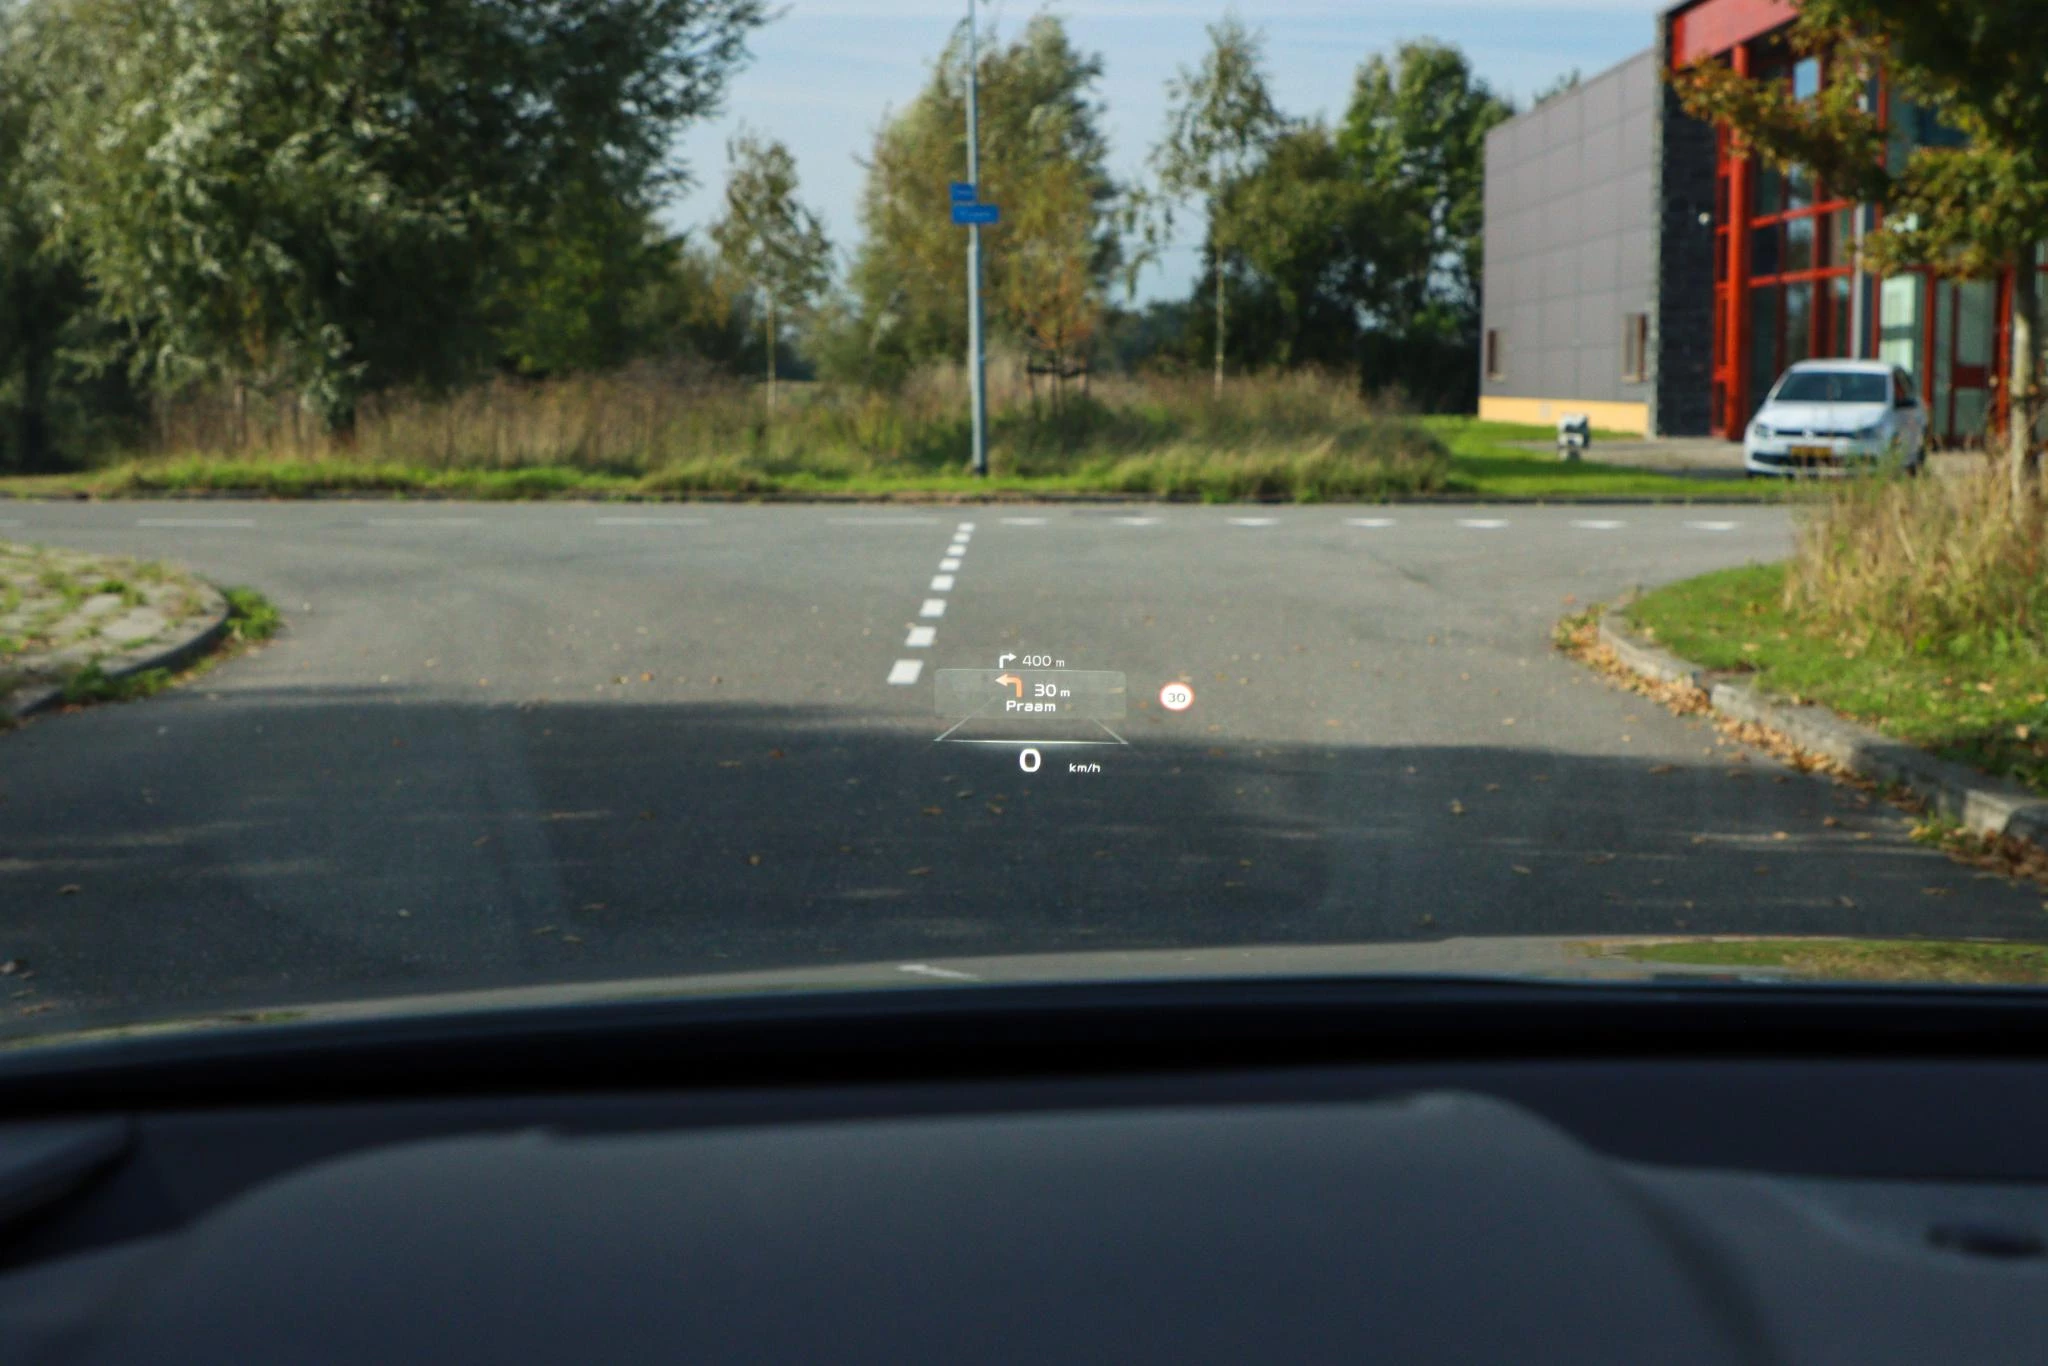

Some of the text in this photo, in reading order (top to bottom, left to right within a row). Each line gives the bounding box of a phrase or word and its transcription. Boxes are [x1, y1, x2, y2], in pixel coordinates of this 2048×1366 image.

[1022, 655, 1065, 667] 400 m
[1034, 684, 1070, 697] 30 m
[1167, 692, 1186, 703] 30
[1006, 700, 1056, 712] Praam
[1019, 748, 1101, 773] 0 km/h
